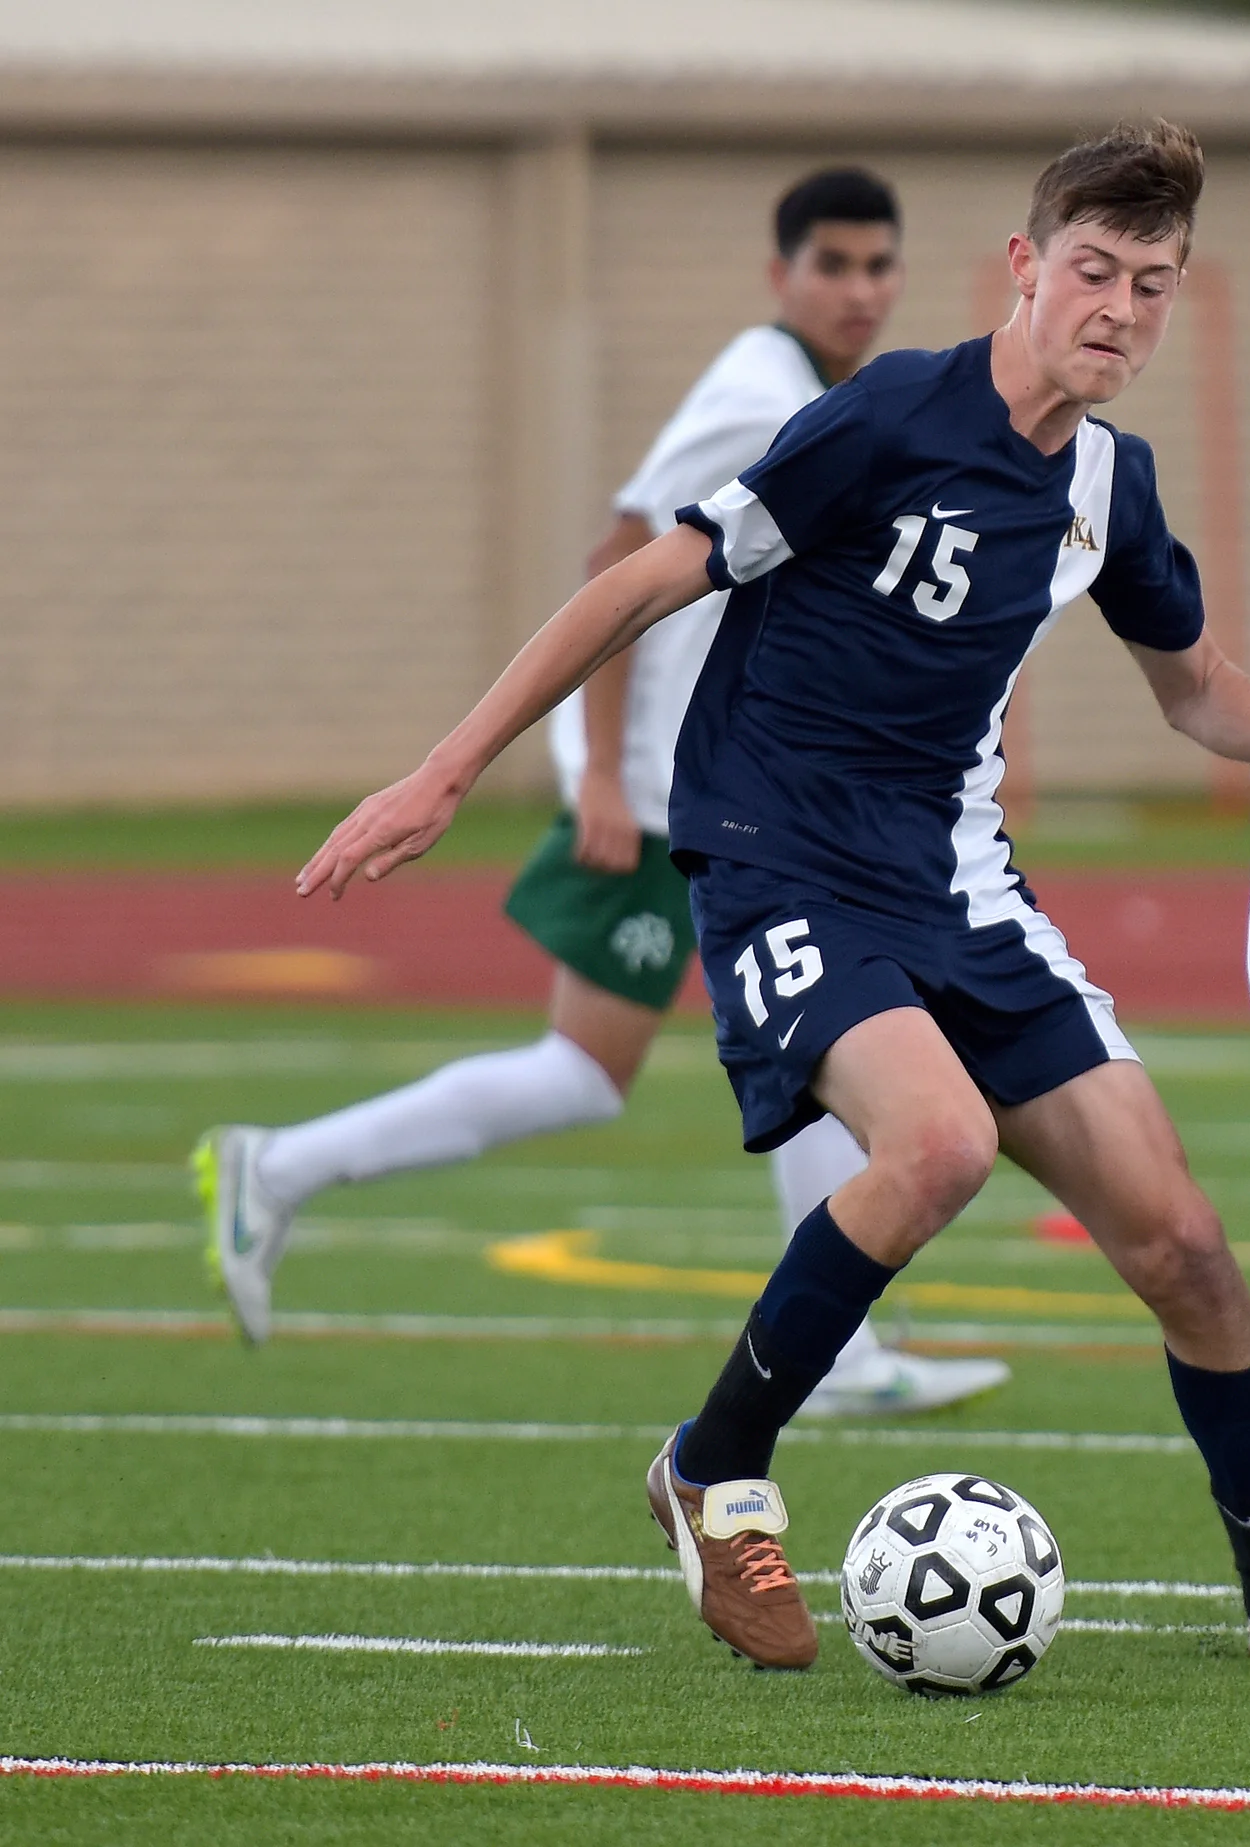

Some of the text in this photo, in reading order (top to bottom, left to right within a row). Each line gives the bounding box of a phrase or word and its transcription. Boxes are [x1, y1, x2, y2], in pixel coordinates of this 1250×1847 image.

[872, 514, 980, 622] 15
[721, 820, 759, 834] DRI-FIT
[735, 918, 824, 1028] 15
[726, 1500, 764, 1516] PUMA
